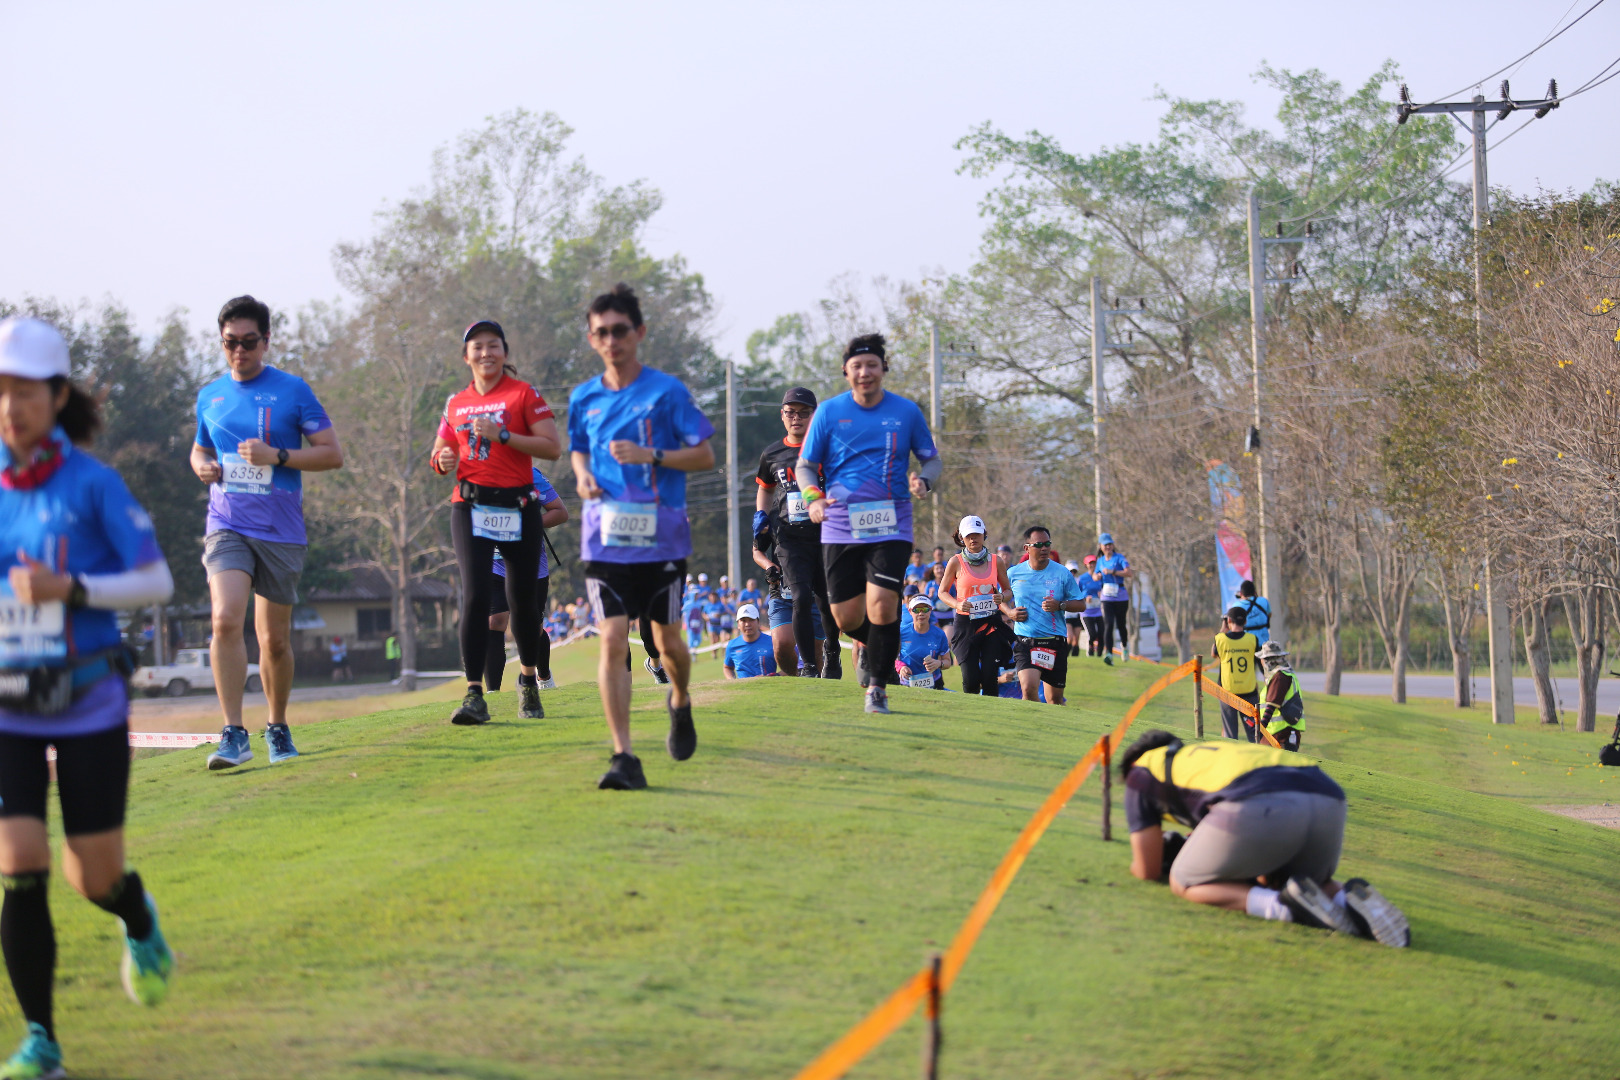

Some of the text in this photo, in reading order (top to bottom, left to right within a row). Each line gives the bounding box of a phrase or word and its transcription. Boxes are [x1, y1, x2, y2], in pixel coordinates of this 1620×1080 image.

[456, 401, 506, 417] INTANIA
[230, 466, 263, 480] 6356
[483, 516, 512, 528] 6017
[610, 517, 648, 532] 6003
[859, 511, 890, 525] 6084
[972, 584, 979, 595] I
[974, 600, 993, 611] 6027
[1227, 656, 1248, 674] 19
[914, 678, 931, 688] 6225
